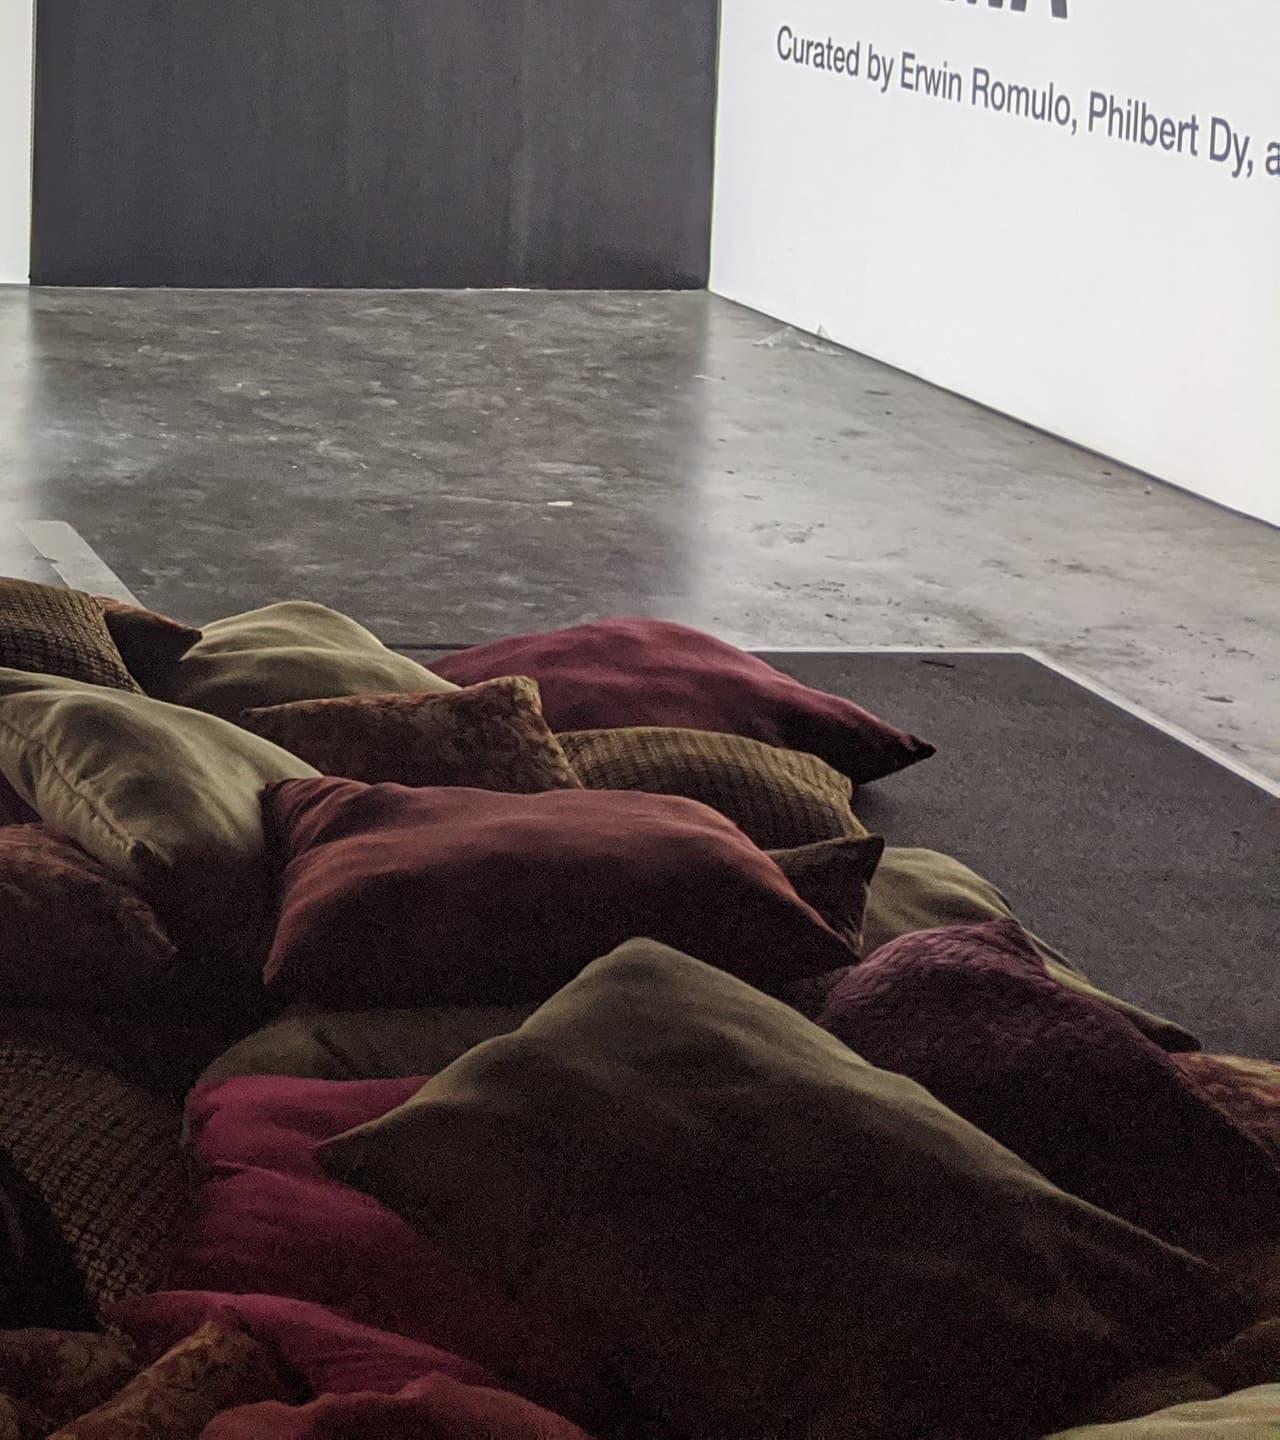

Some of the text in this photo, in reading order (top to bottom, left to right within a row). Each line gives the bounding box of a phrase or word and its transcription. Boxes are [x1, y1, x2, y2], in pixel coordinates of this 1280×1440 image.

[776, 25, 861, 77] Curated
[866, 44, 895, 94] by
[900, 51, 963, 102] Erwin
[971, 67, 1078, 134] Romulo,
[1087, 90, 1200, 157] Philbert
[1208, 116, 1254, 179] Dy,
